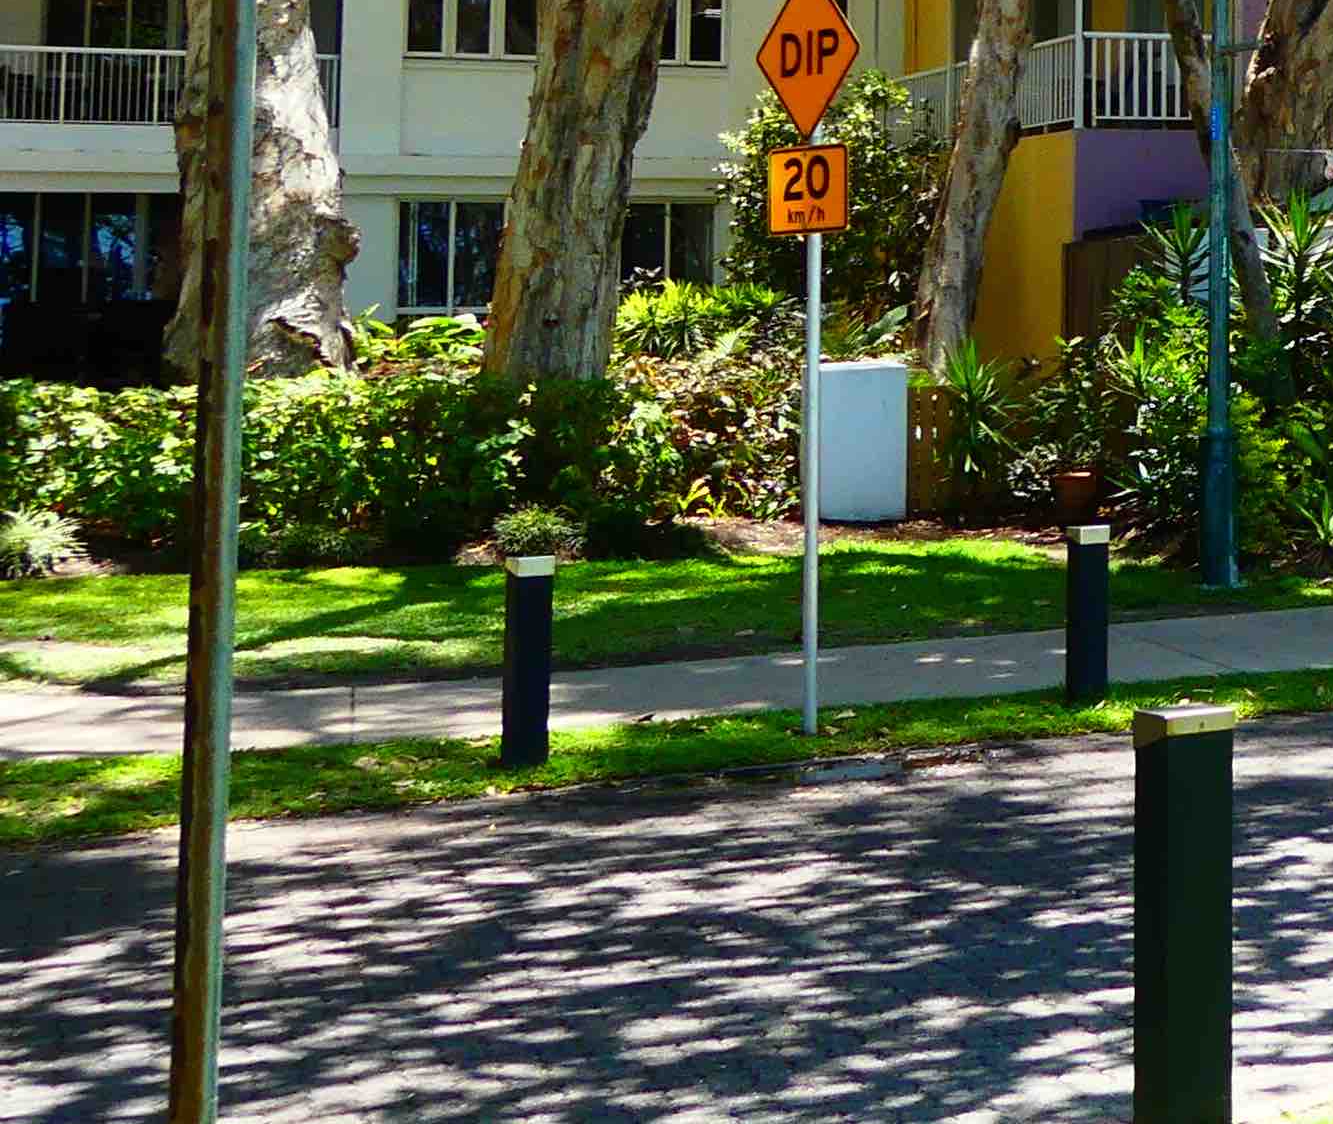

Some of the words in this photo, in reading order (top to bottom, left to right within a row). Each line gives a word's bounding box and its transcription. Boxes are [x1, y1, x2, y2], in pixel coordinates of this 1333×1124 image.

[780, 28, 839, 78] DIP
[783, 155, 830, 201] 20
[787, 205, 825, 225] km/h
